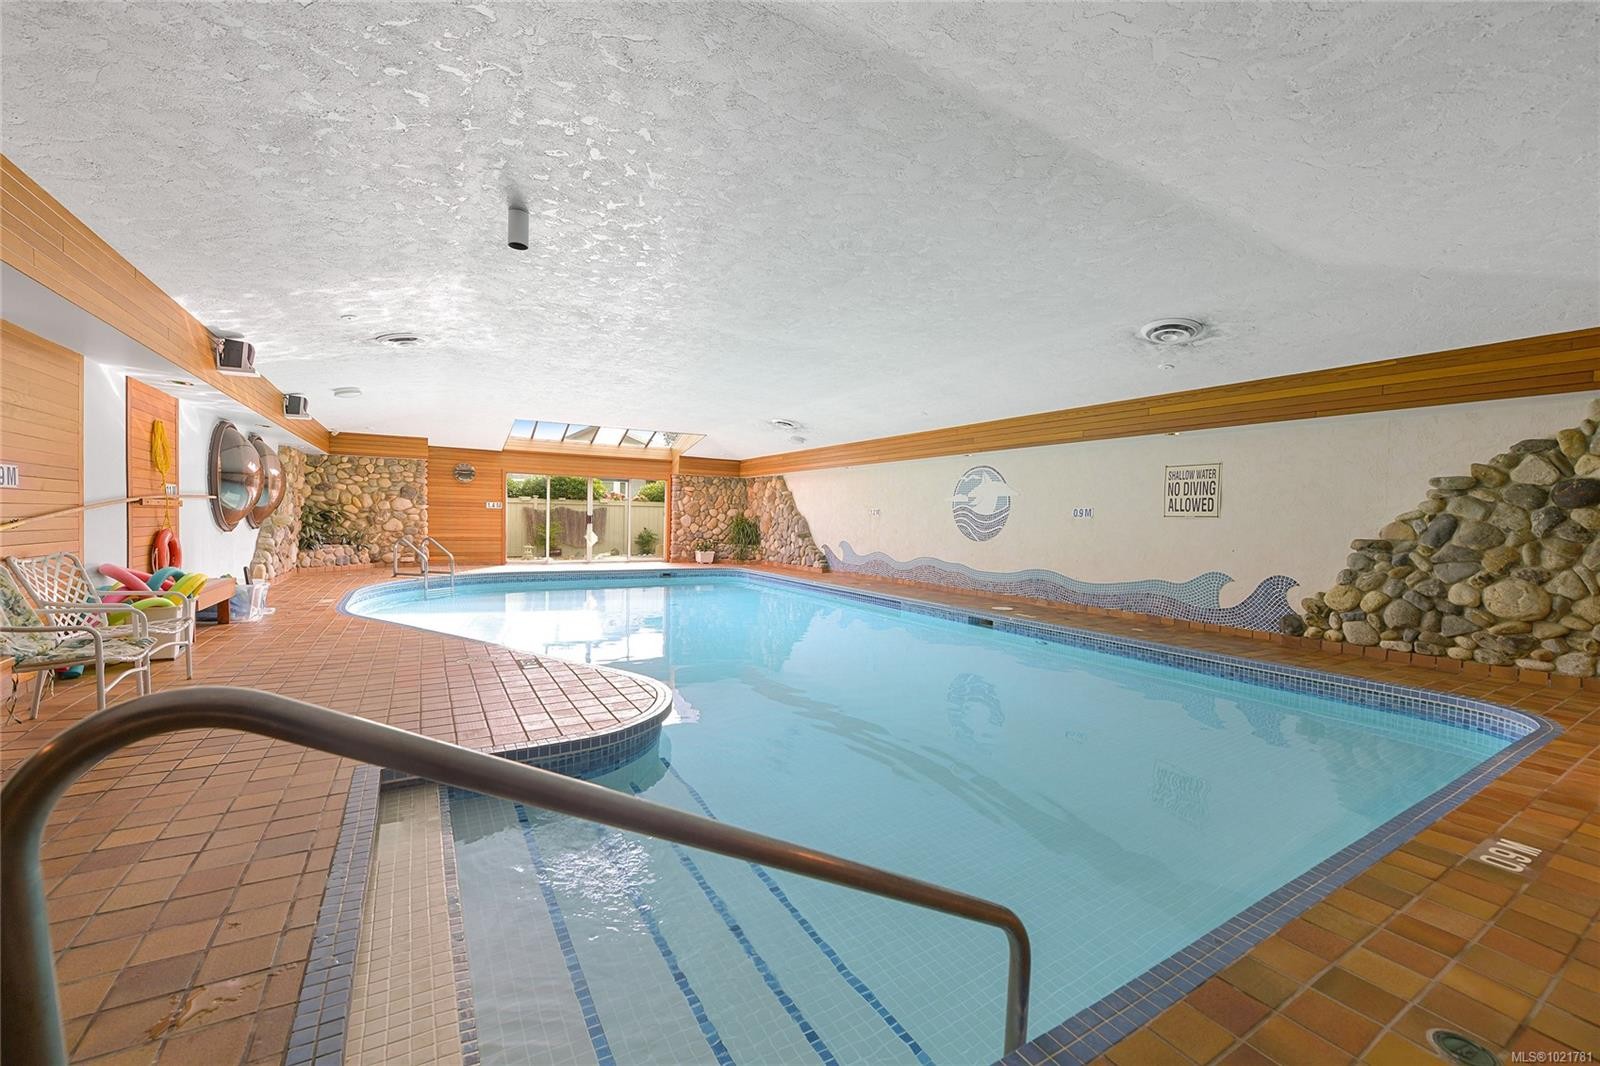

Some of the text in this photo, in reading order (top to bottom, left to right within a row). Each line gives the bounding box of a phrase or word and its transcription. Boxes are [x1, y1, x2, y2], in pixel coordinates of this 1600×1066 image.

[1168, 469, 1216, 480] SHALLOW WATER
[1168, 481, 1216, 496] NO DIVING
[1168, 497, 1214, 512] ALLOWED
